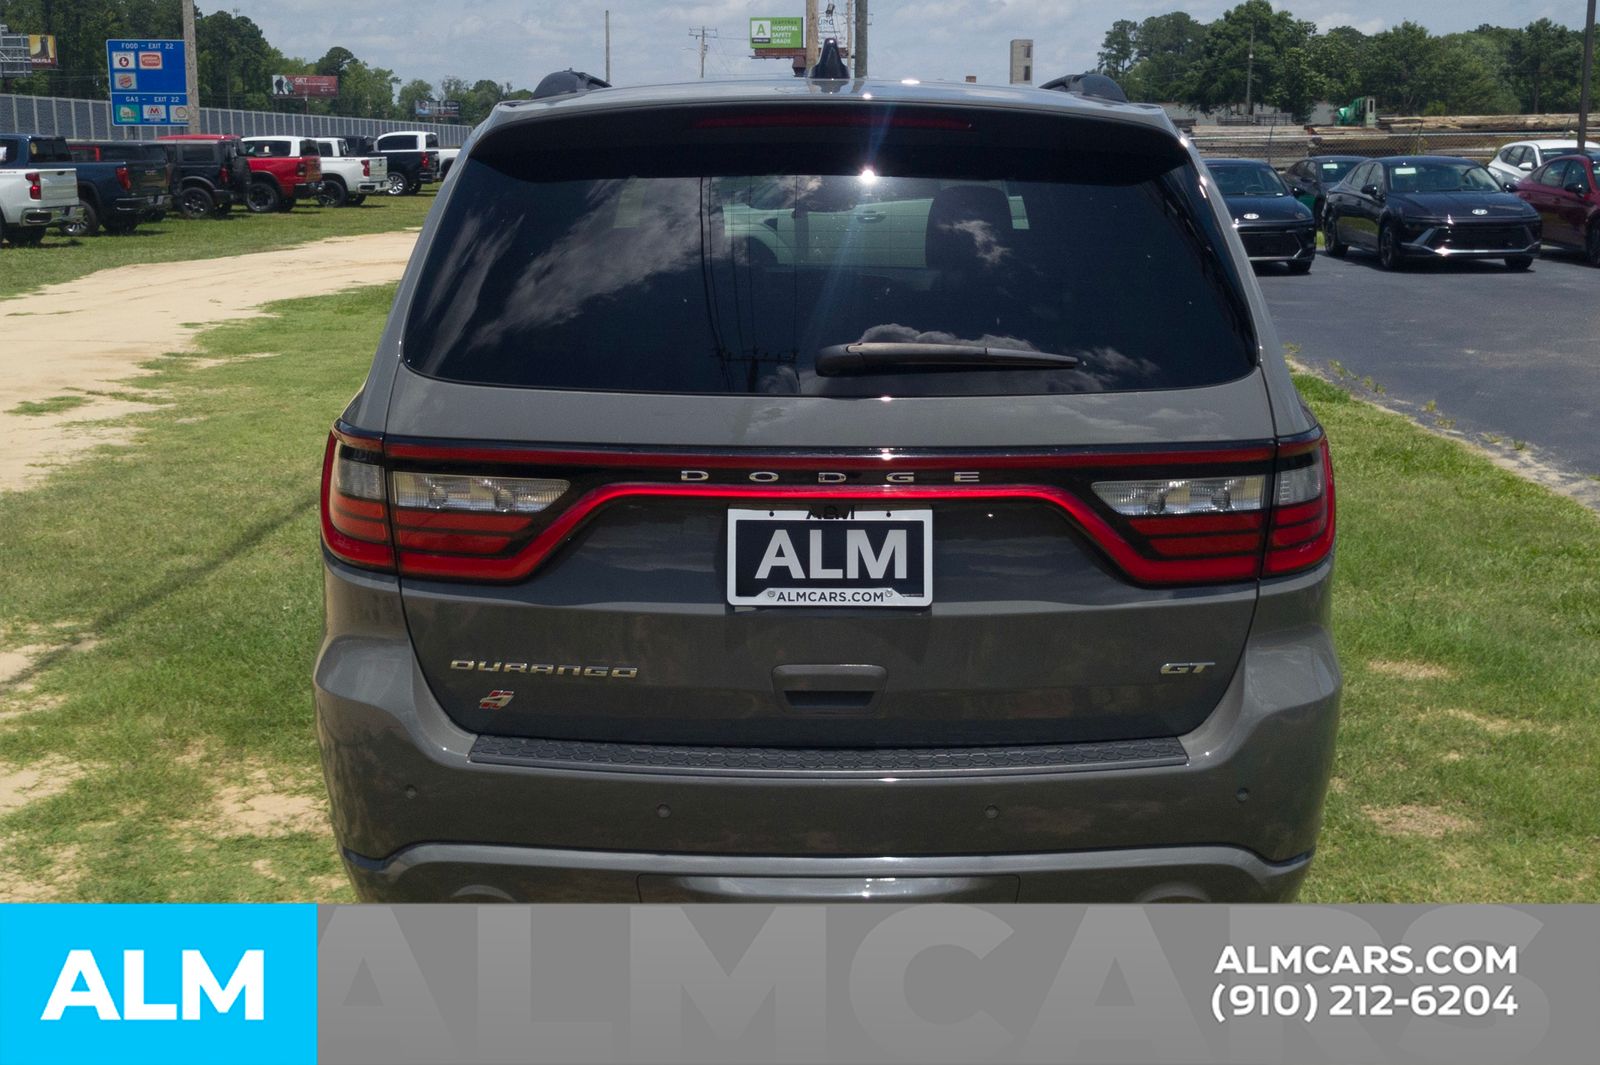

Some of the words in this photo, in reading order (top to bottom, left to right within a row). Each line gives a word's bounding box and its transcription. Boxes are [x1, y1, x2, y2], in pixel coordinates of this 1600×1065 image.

[756, 23, 766, 36] A
[681, 470, 980, 483] DODGE
[755, 529, 908, 579] ALM
[776, 591, 884, 603] ALMCARS.COM
[450, 660, 638, 678] DURANGO
[1160, 662, 1216, 674] GT
